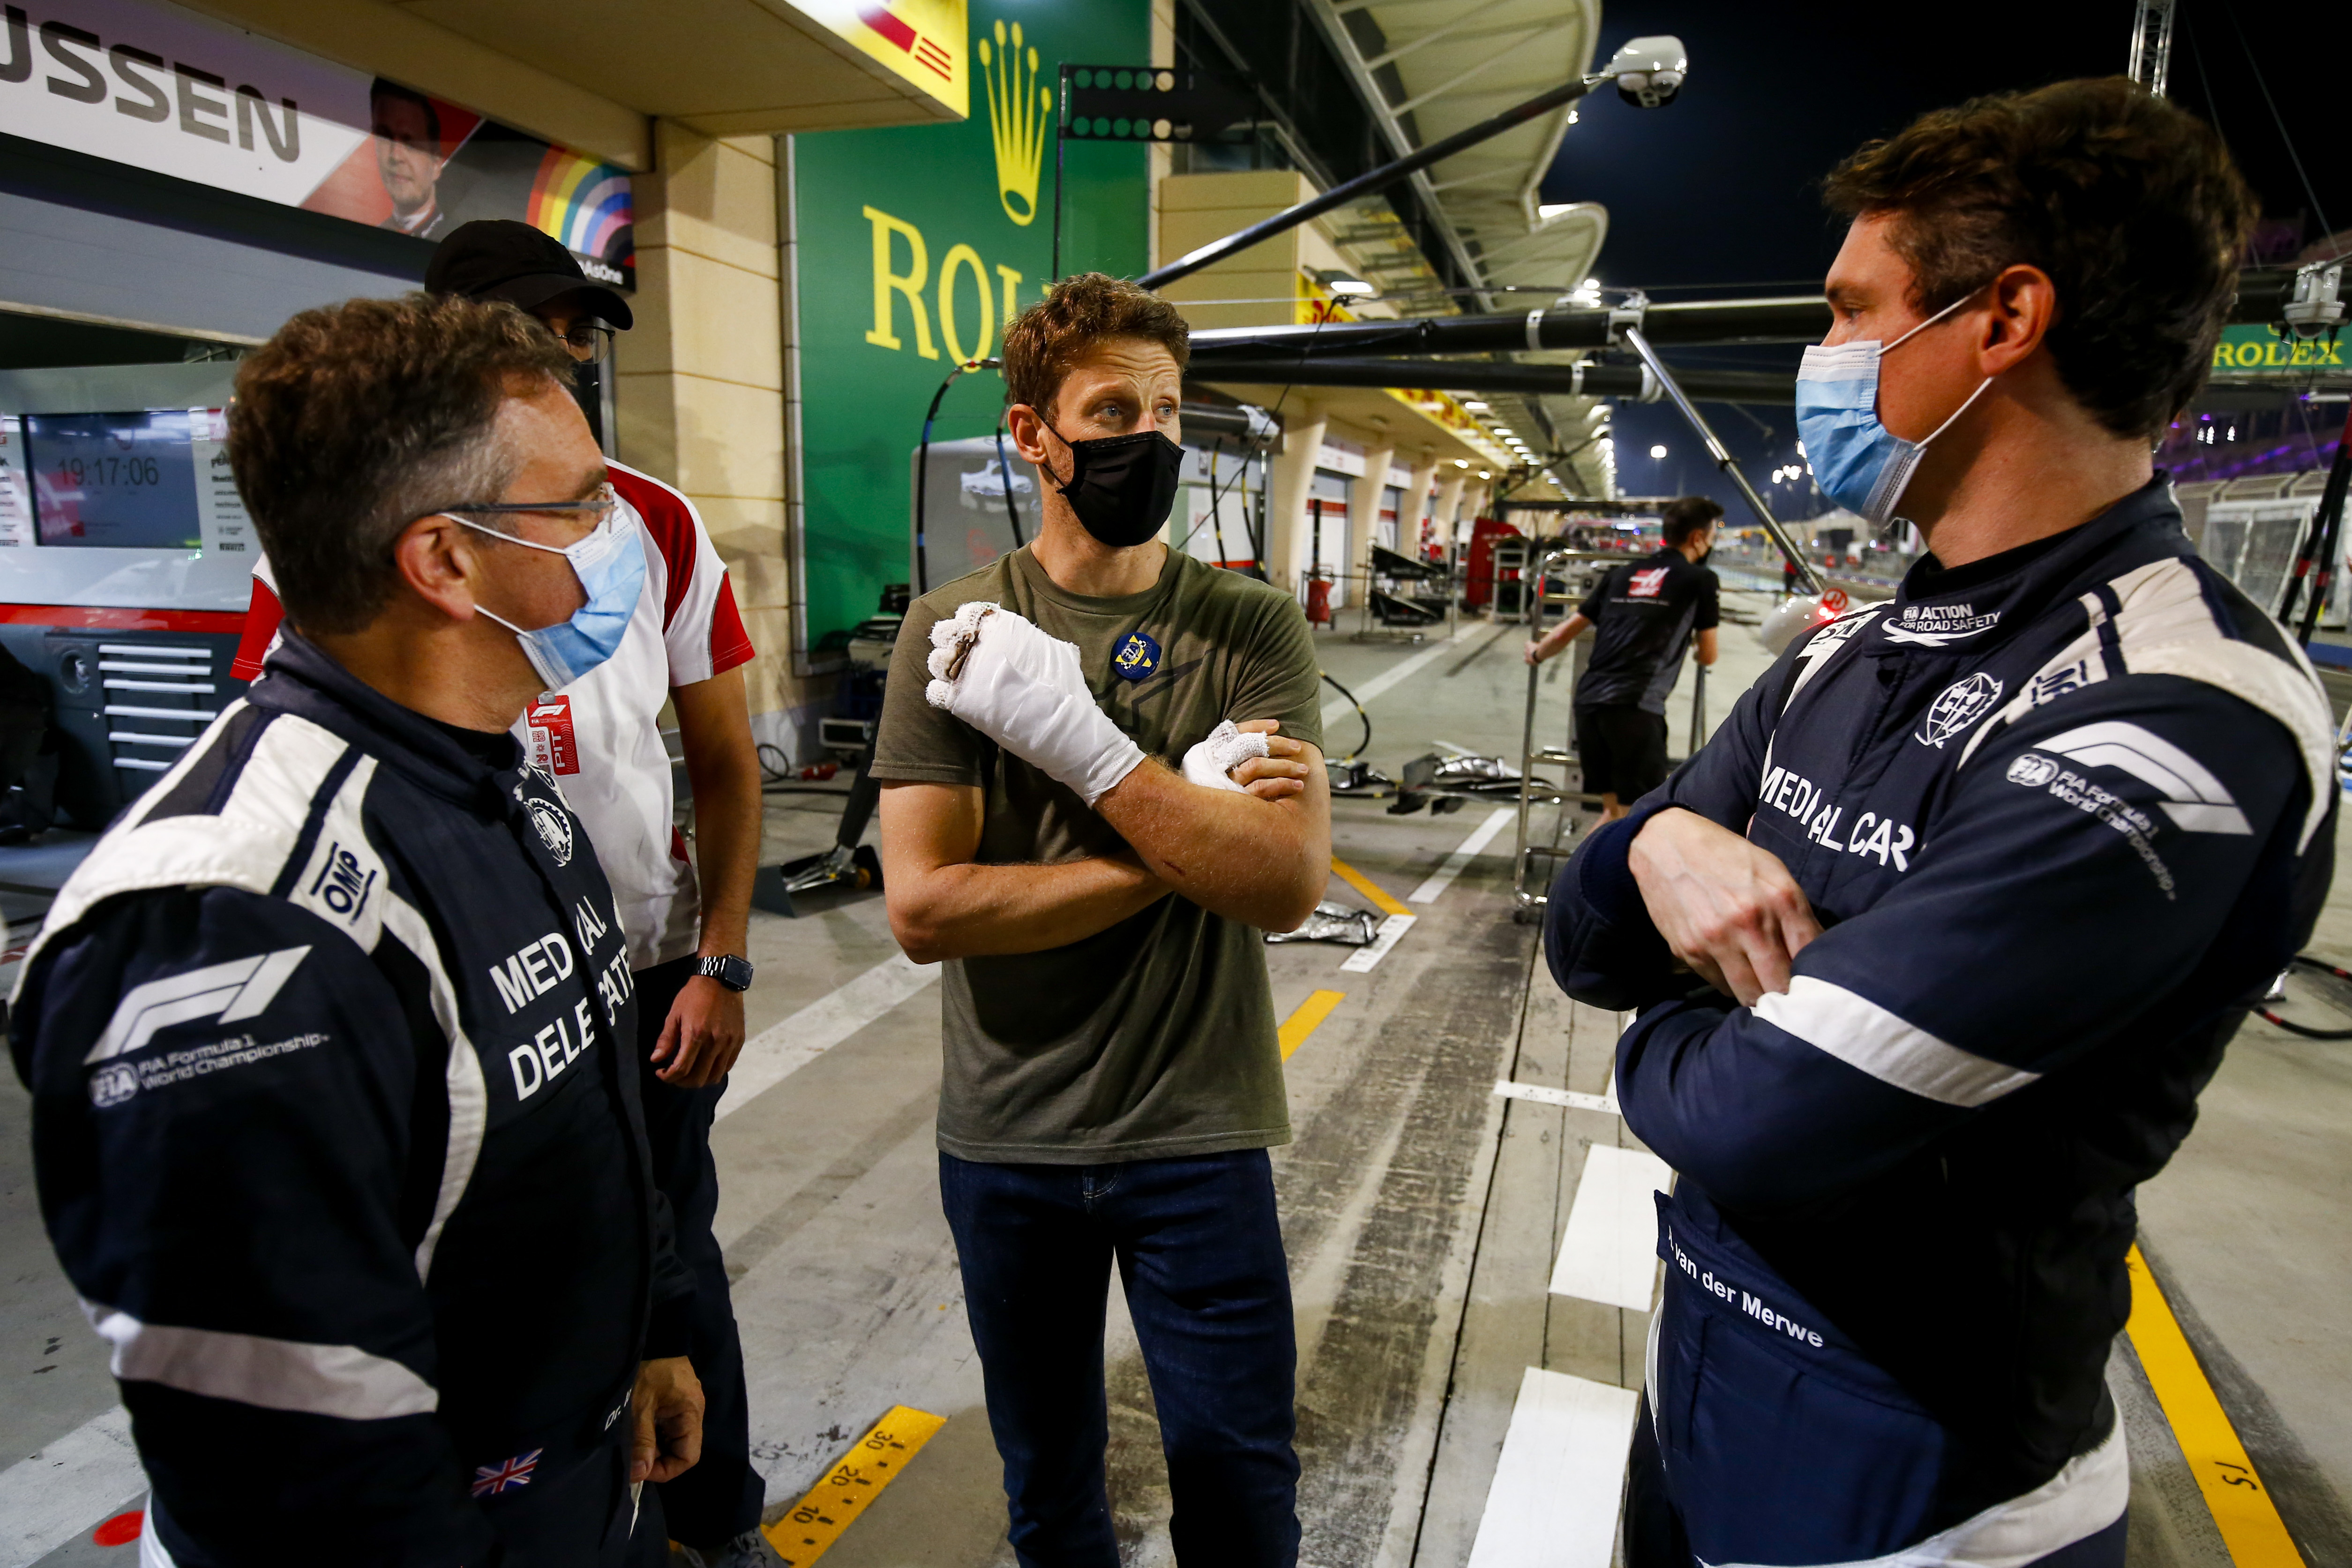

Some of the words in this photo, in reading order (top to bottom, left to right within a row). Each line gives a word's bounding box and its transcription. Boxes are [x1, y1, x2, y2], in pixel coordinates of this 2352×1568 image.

[2212, 341, 2343, 368] ROLEX
[58, 457, 159, 486] 19:17:06
[1916, 620, 1950, 632] ROAD
[1952, 611, 2001, 631] SAFETY
[1919, 603, 1974, 620] ACTION
[551, 730, 565, 768] PIT
[2009, 758, 2052, 785] FIA
[2056, 770, 2087, 794] FIA
[2048, 780, 2100, 812] World
[1759, 766, 1844, 852] MEDIAL
[1848, 812, 1915, 872] CAR
[323, 851, 364, 914] OMP
[138, 1057, 167, 1075] FIA
[167, 1036, 242, 1067] Formula
[241, 1034, 256, 1047] 1
[141, 1062, 195, 1090] World
[194, 1033, 321, 1075] Championship
[94, 1069, 137, 1103] FIA
[1675, 1242, 1697, 1279] van
[1702, 1271, 1736, 1303] der
[1742, 1290, 1824, 1348] Merwe
[605, 1405, 621, 1431] Dr.
[866, 1430, 893, 1450] 30
[831, 1465, 859, 1486] 20
[793, 1506, 820, 1524] 10
